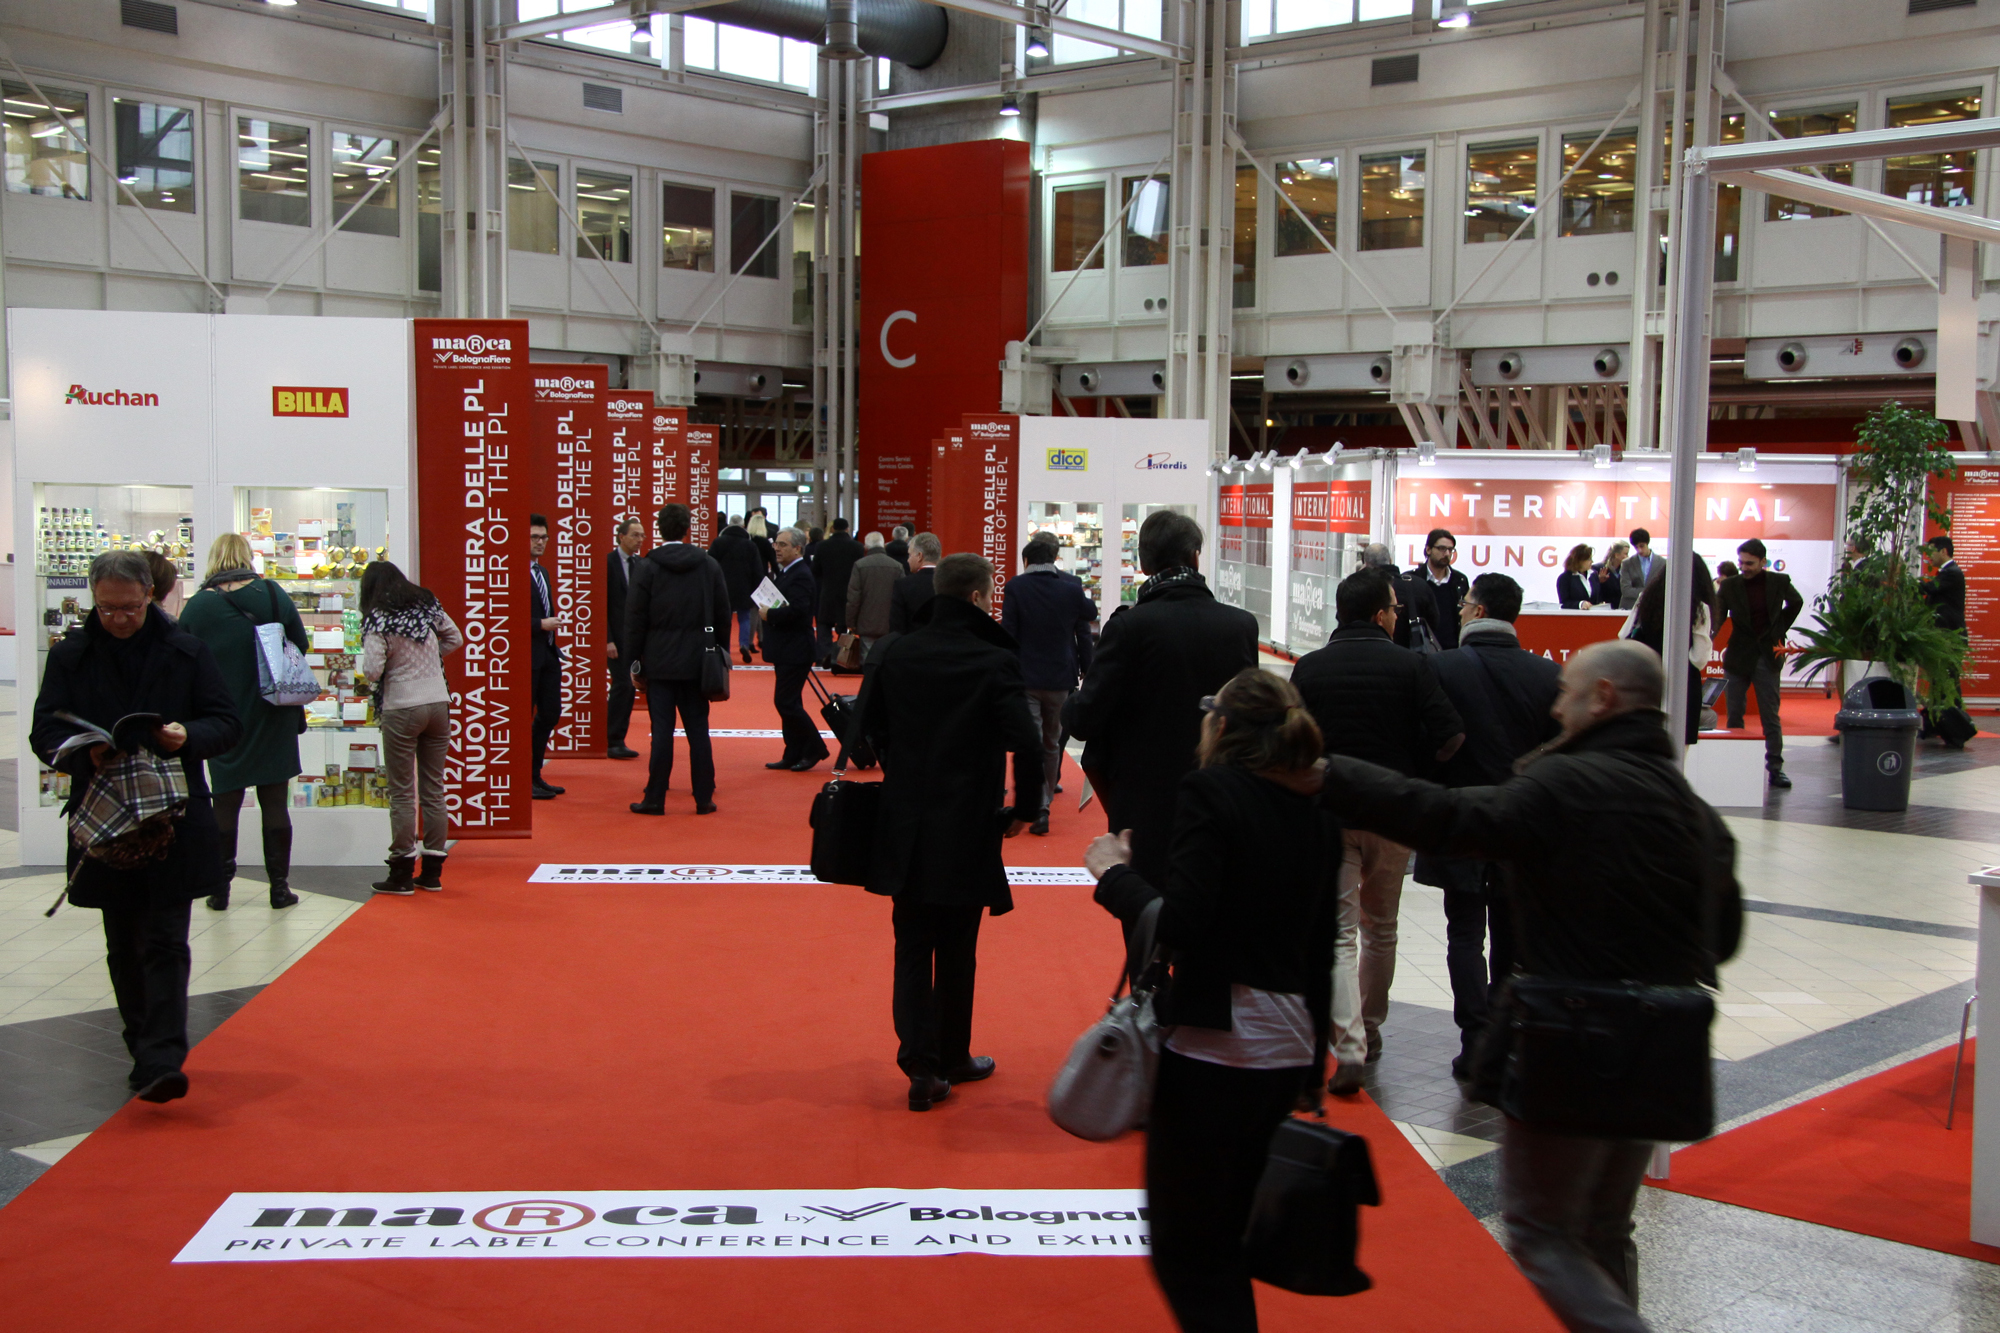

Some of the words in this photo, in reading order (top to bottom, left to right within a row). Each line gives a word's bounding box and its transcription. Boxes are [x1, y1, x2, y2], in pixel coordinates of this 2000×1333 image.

[880, 310, 916, 368] C
[453, 354, 512, 365] BolognaFiere
[65, 384, 159, 406] Auchan
[278, 391, 344, 413] BILLA
[464, 379, 484, 411] PL
[550, 391, 594, 399] BolognaFiere
[488, 403, 508, 434] PL
[558, 410, 573, 435] PL
[576, 428, 591, 452] PL
[613, 427, 626, 447] PL
[628, 442, 640, 461] PL
[653, 438, 664, 455] PL
[465, 422, 484, 508] DELLE
[665, 451, 676, 467] PL
[691, 450, 700, 464] PL
[700, 460, 710, 474] PL
[985, 445, 996, 461] PL
[997, 457, 1008, 473] PL
[1051, 449, 1083, 465] dico
[488, 445, 508, 497] THE
[558, 442, 573, 508] DELLE
[576, 460, 591, 500] THE
[613, 453, 626, 506] DELLE
[628, 467, 640, 500] THE
[653, 460, 664, 504] DELLE
[665, 472, 676, 498] THE
[691, 467, 700, 504] DELLE
[700, 476, 710, 500] THE
[984, 466, 996, 510] DELLE
[996, 478, 1007, 502] THE
[700, 504, 709, 520] OF
[996, 509, 1007, 529] OF
[1220, 496, 1269, 515] INTERNATIONAL
[1294, 496, 1364, 518] INTERNATIONAL
[1409, 493, 1790, 522] INTERNATINAL
[489, 507, 509, 544] OF
[576, 507, 591, 536] OF
[1294, 540, 1324, 561] LOUNGE
[558, 516, 573, 636] FRONTIERA
[994, 533, 1006, 603] FRONTIER
[466, 518, 486, 676] FRONTIERA
[576, 544, 591, 647] FRONTIER
[489, 554, 510, 690] FRONTIER
[558, 644, 573, 716] NUOVA
[576, 655, 591, 703] NEW
[466, 686, 486, 782] NUOVA
[490, 700, 510, 764] NEW
[558, 724, 573, 750] LA
[576, 712, 591, 750] THE
[466, 792, 486, 826] LA
[490, 774, 510, 826] THE
[784, 1212, 817, 1224] by
[225, 1237, 406, 1251] PRIVATE
[430, 1236, 559, 1247] LABEL
[584, 1234, 890, 1247] CONFERENCE
[914, 1233, 1012, 1246] AND
